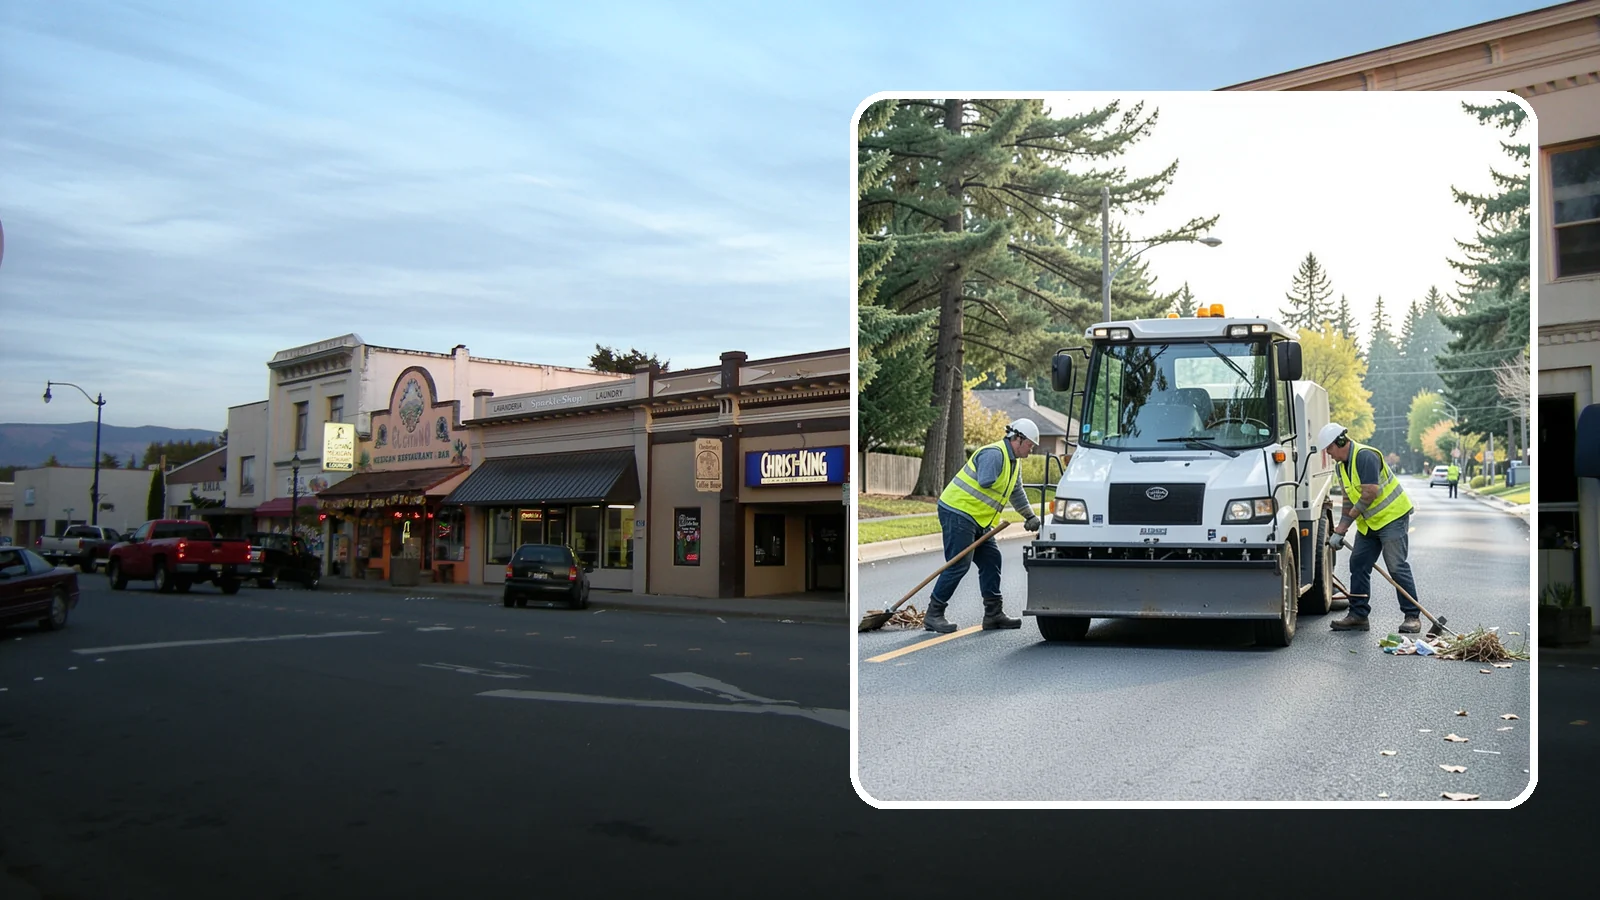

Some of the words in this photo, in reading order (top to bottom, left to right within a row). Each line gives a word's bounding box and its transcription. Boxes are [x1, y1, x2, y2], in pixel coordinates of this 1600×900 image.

[595, 388, 624, 400] LAUNDRY
[493, 402, 523, 413] LAVANDERIA
[530, 396, 561, 409] Sparkle
[561, 395, 582, 406] Shop
[373, 455, 396, 464] MEXICAN
[397, 451, 433, 462] RESTAURANT
[438, 450, 450, 459] BAR
[696, 481, 709, 489] Coffee
[710, 480, 722, 489] House
